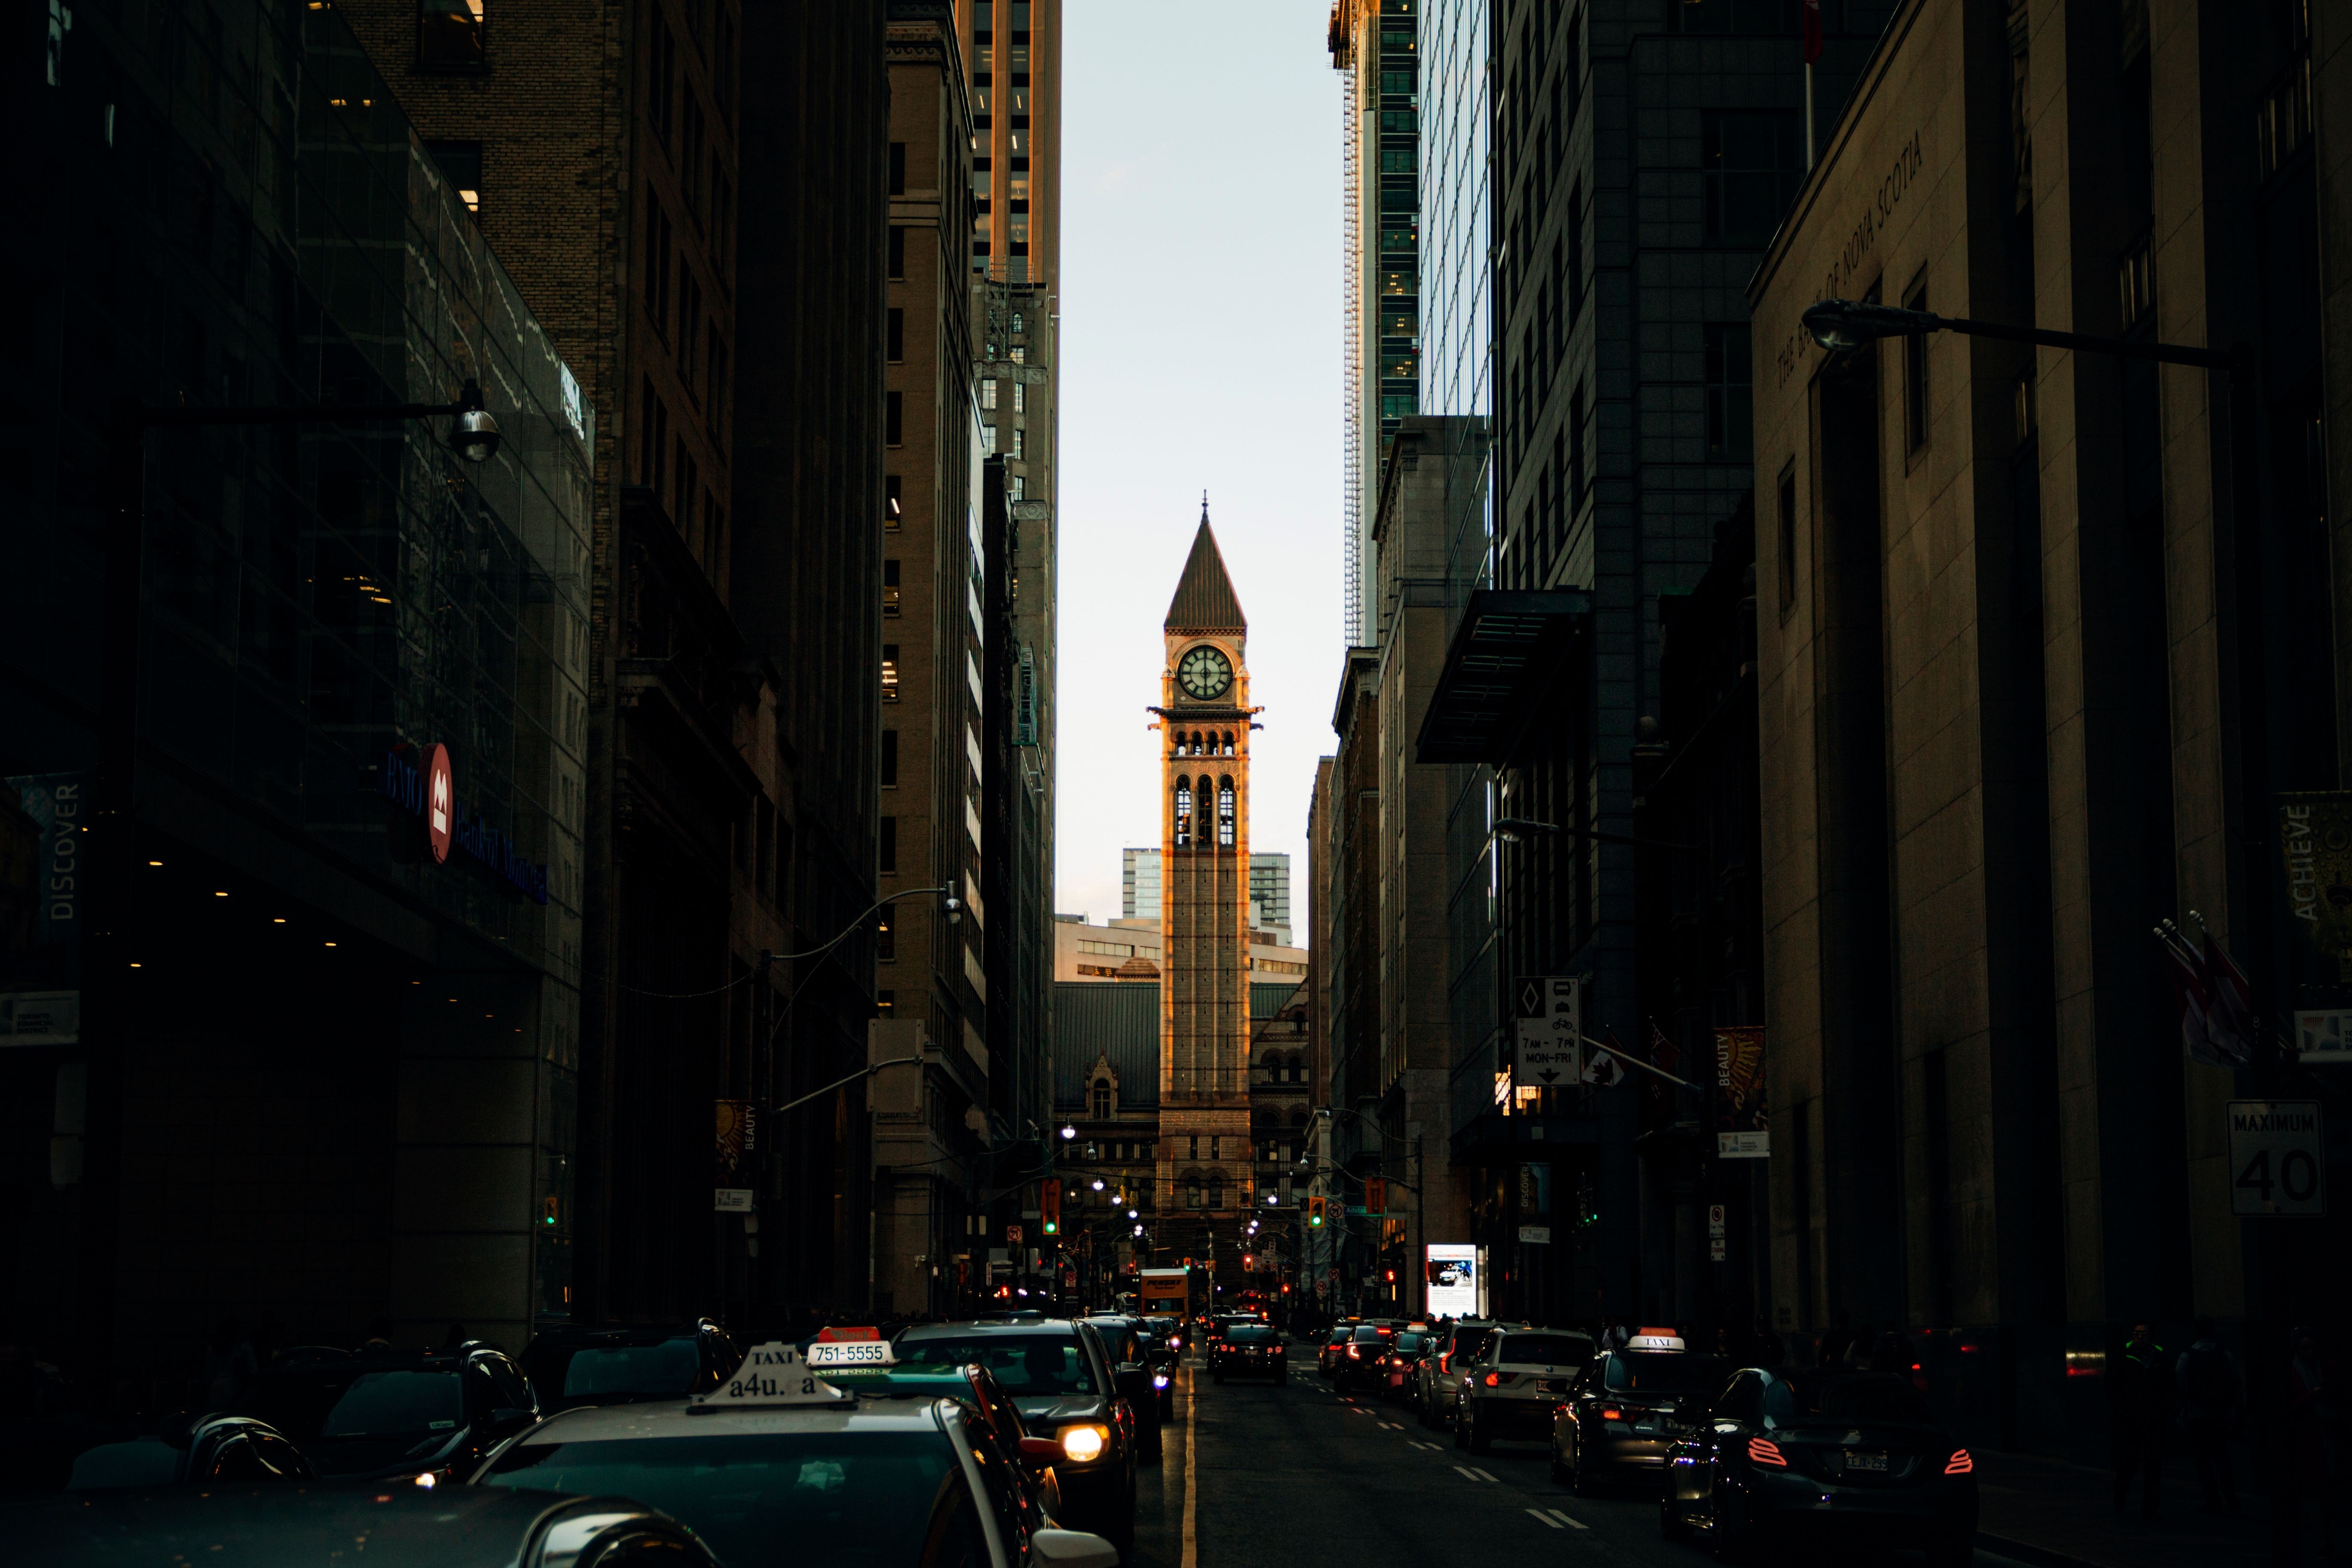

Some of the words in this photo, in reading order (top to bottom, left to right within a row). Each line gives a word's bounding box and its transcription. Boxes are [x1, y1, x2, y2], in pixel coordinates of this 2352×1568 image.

[1778, 336, 1794, 389] THE
[1844, 207, 1874, 286] NOVA
[1879, 128, 1922, 230] SCOTIA
[386, 750, 423, 816] BMO
[50, 783, 79, 920] DISCOVER
[455, 800, 486, 862] Bank
[2286, 805, 2318, 921] ACHIEVE
[1526, 1054, 1571, 1063] MON-FRI
[1717, 1035, 1730, 1087] BEAUTY
[745, 1105, 756, 1150] BEAUTY
[2234, 1114, 2314, 1131] MAXIMUM
[2236, 1149, 2318, 1202] 40
[752, 1352, 793, 1365] TAXI
[816, 1346, 883, 1361] 751-5555
[840, 1330, 869, 1341] Beck
